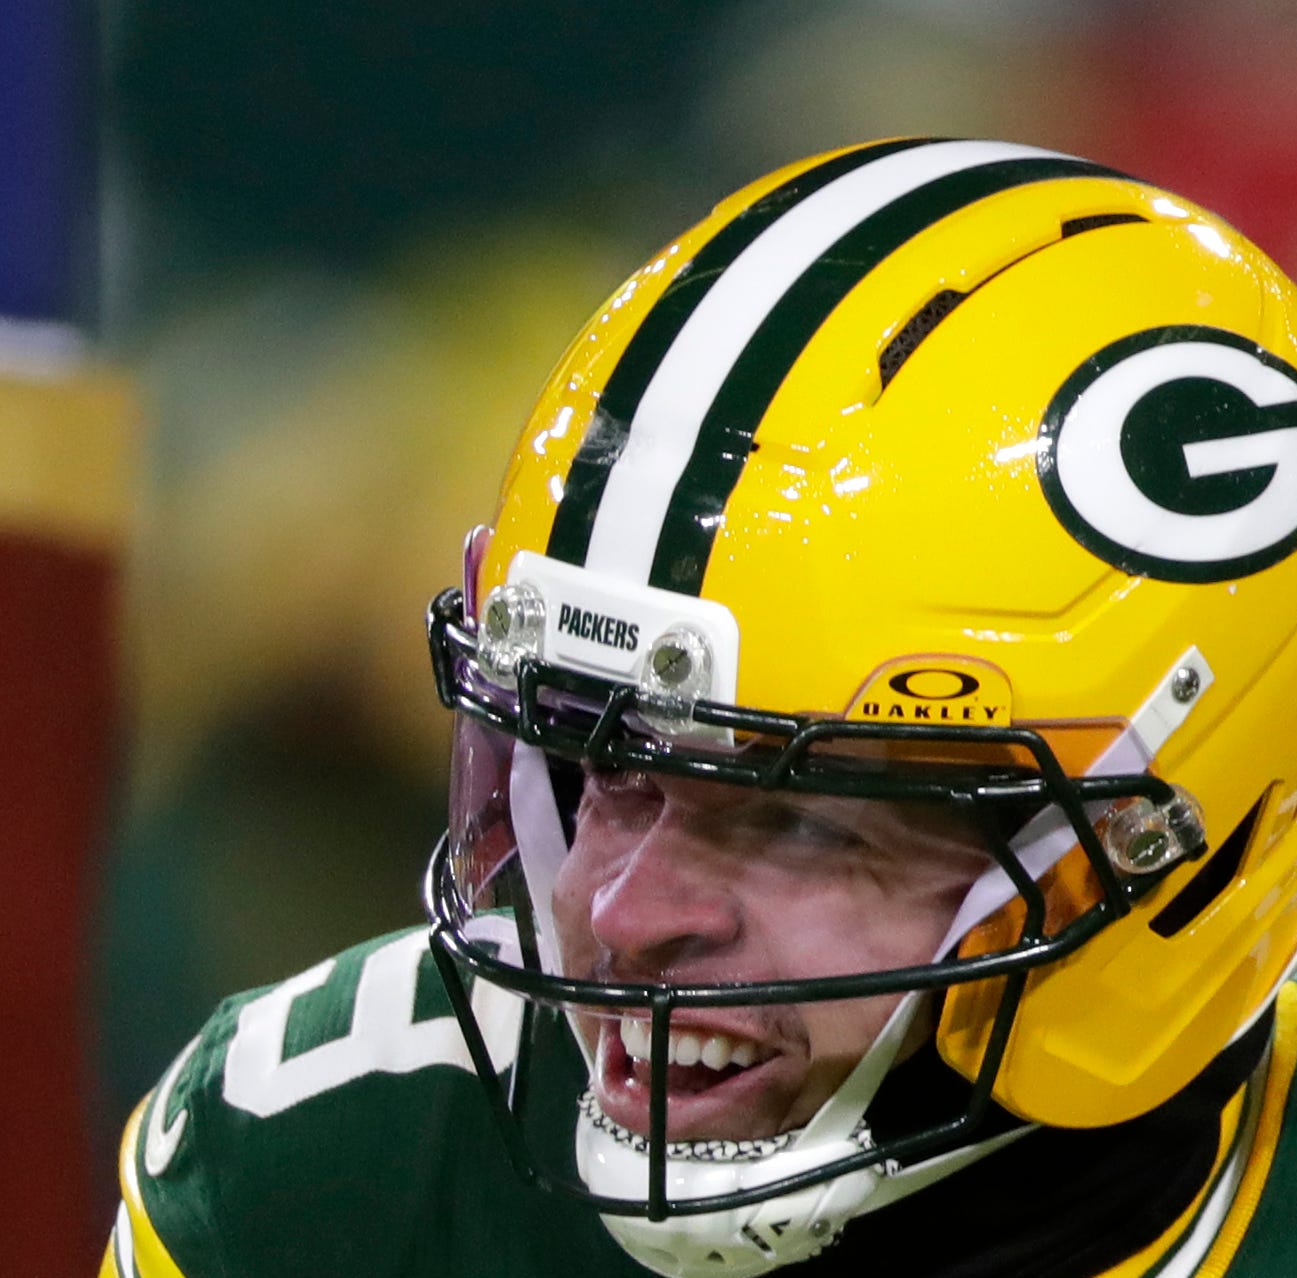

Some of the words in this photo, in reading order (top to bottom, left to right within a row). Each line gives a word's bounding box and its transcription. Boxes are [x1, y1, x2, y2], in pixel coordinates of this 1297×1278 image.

[557, 603, 640, 651] PACKERS
[862, 703, 999, 720] OAKLEY
[222, 913, 528, 1118] 9
